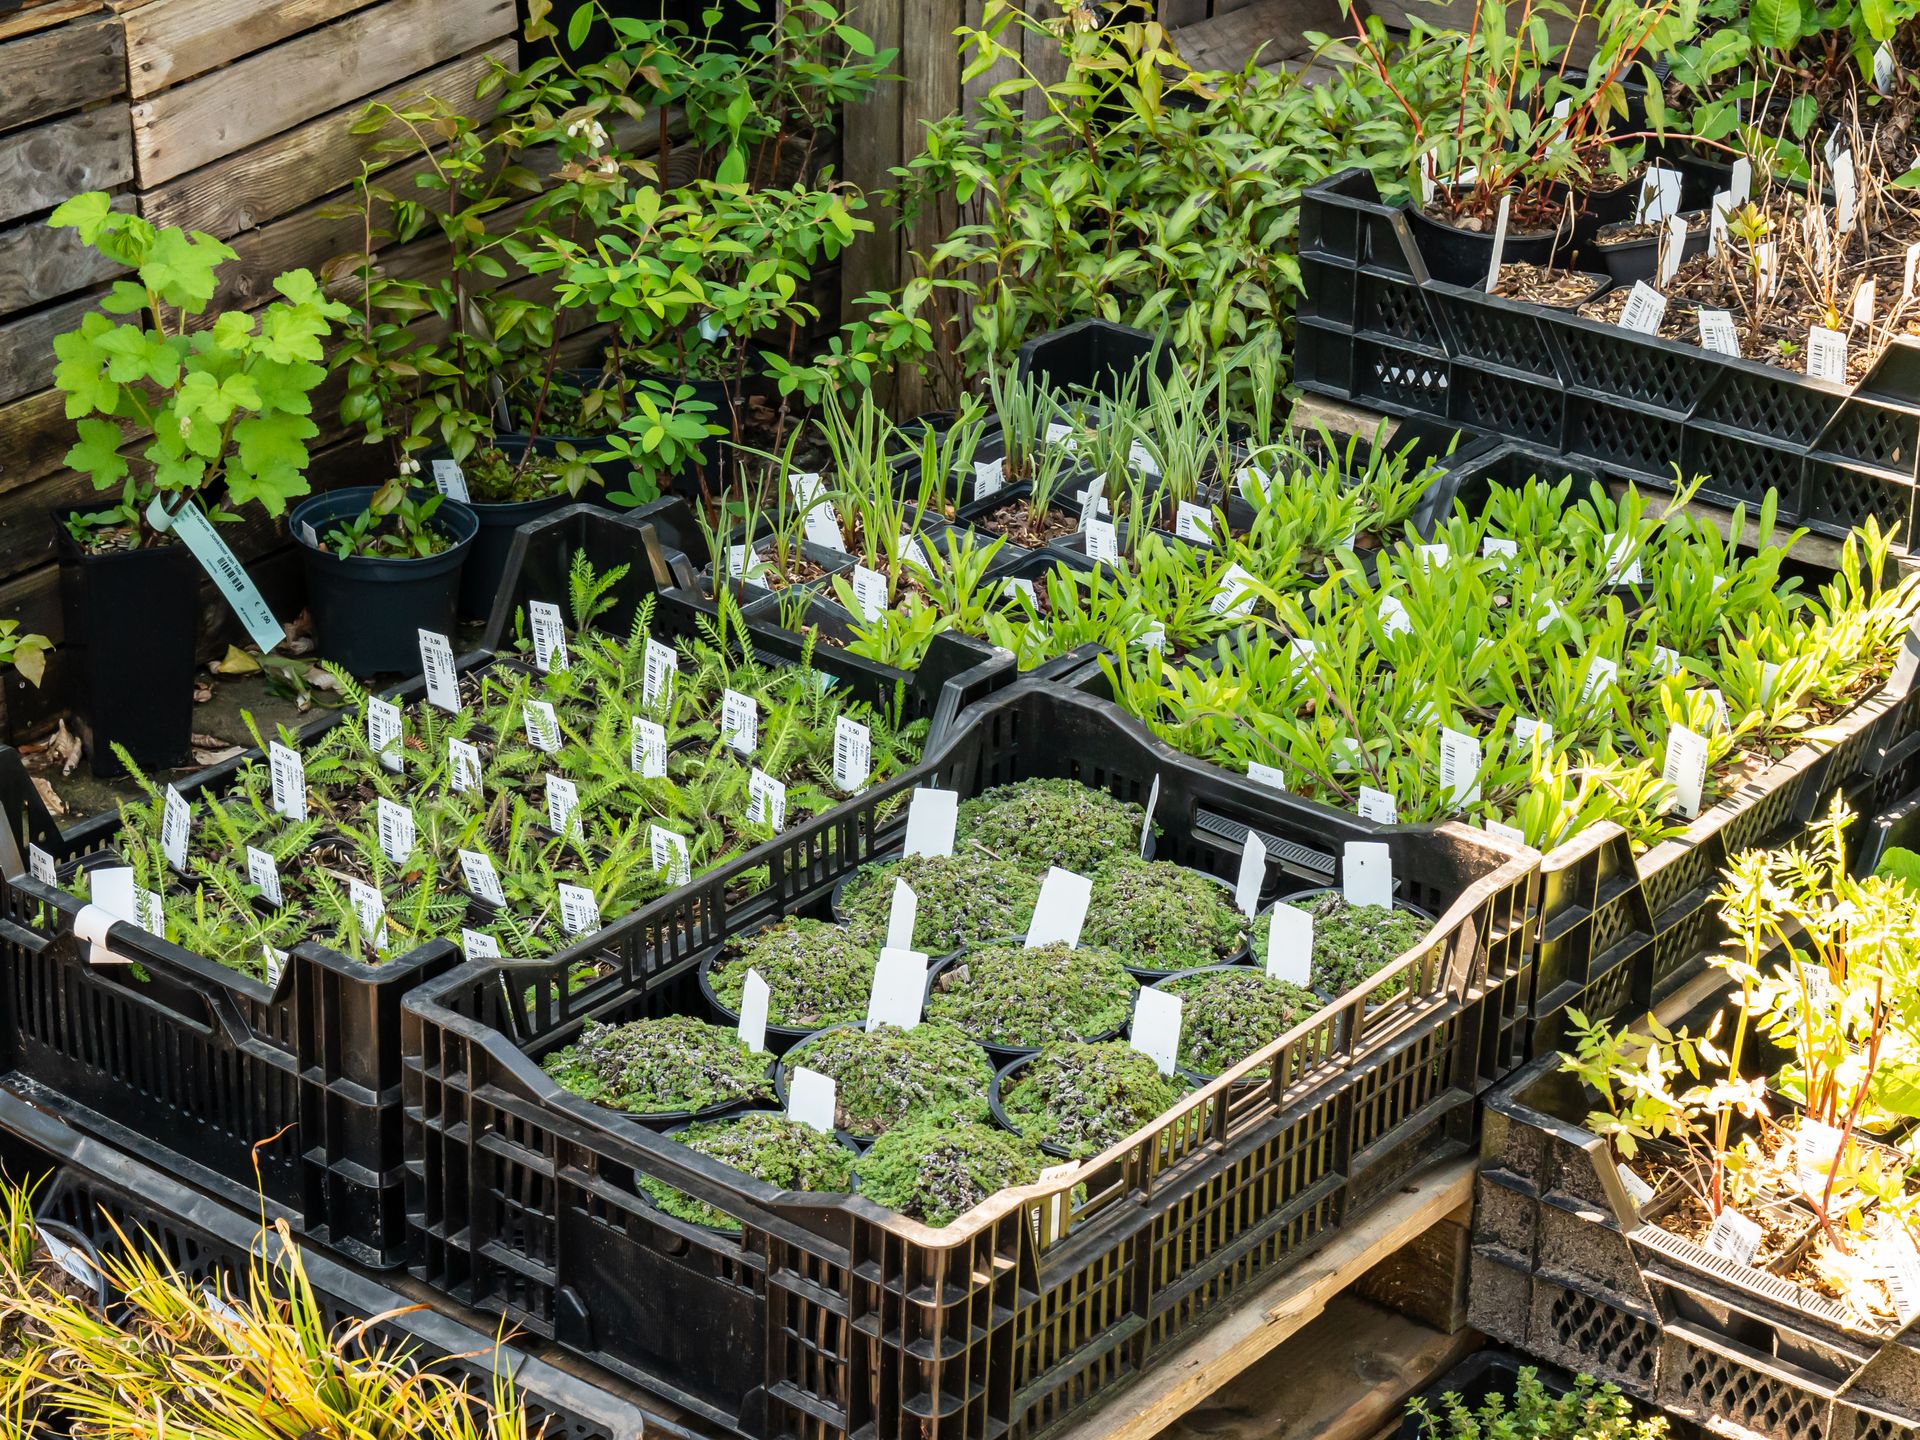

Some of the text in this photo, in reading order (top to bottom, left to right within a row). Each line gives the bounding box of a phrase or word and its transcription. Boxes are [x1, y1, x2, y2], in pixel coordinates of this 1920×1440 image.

[260, 610, 271, 625] 7,00
[429, 637, 441, 646] 3,50
[657, 649, 668, 658] 3,50
[448, 652, 456, 674] Achillea
[735, 699, 747, 708] 3,50
[379, 706, 391, 715] 3,50
[643, 727, 655, 736] 3,50
[848, 726, 859, 736] 3,50
[281, 752, 292, 761] 3,50
[459, 749, 470, 757] 3,50
[557, 784, 568, 793] 3,50
[763, 780, 775, 791] 3,50
[175, 798, 183, 810] 3,50
[390, 808, 402, 818] 3,50
[257, 856, 267, 865] 3,50
[471, 858, 482, 868] 3,50
[361, 890, 373, 900] 3,50
[572, 893, 584, 901] 3,50
[475, 939, 487, 948] 3,50
